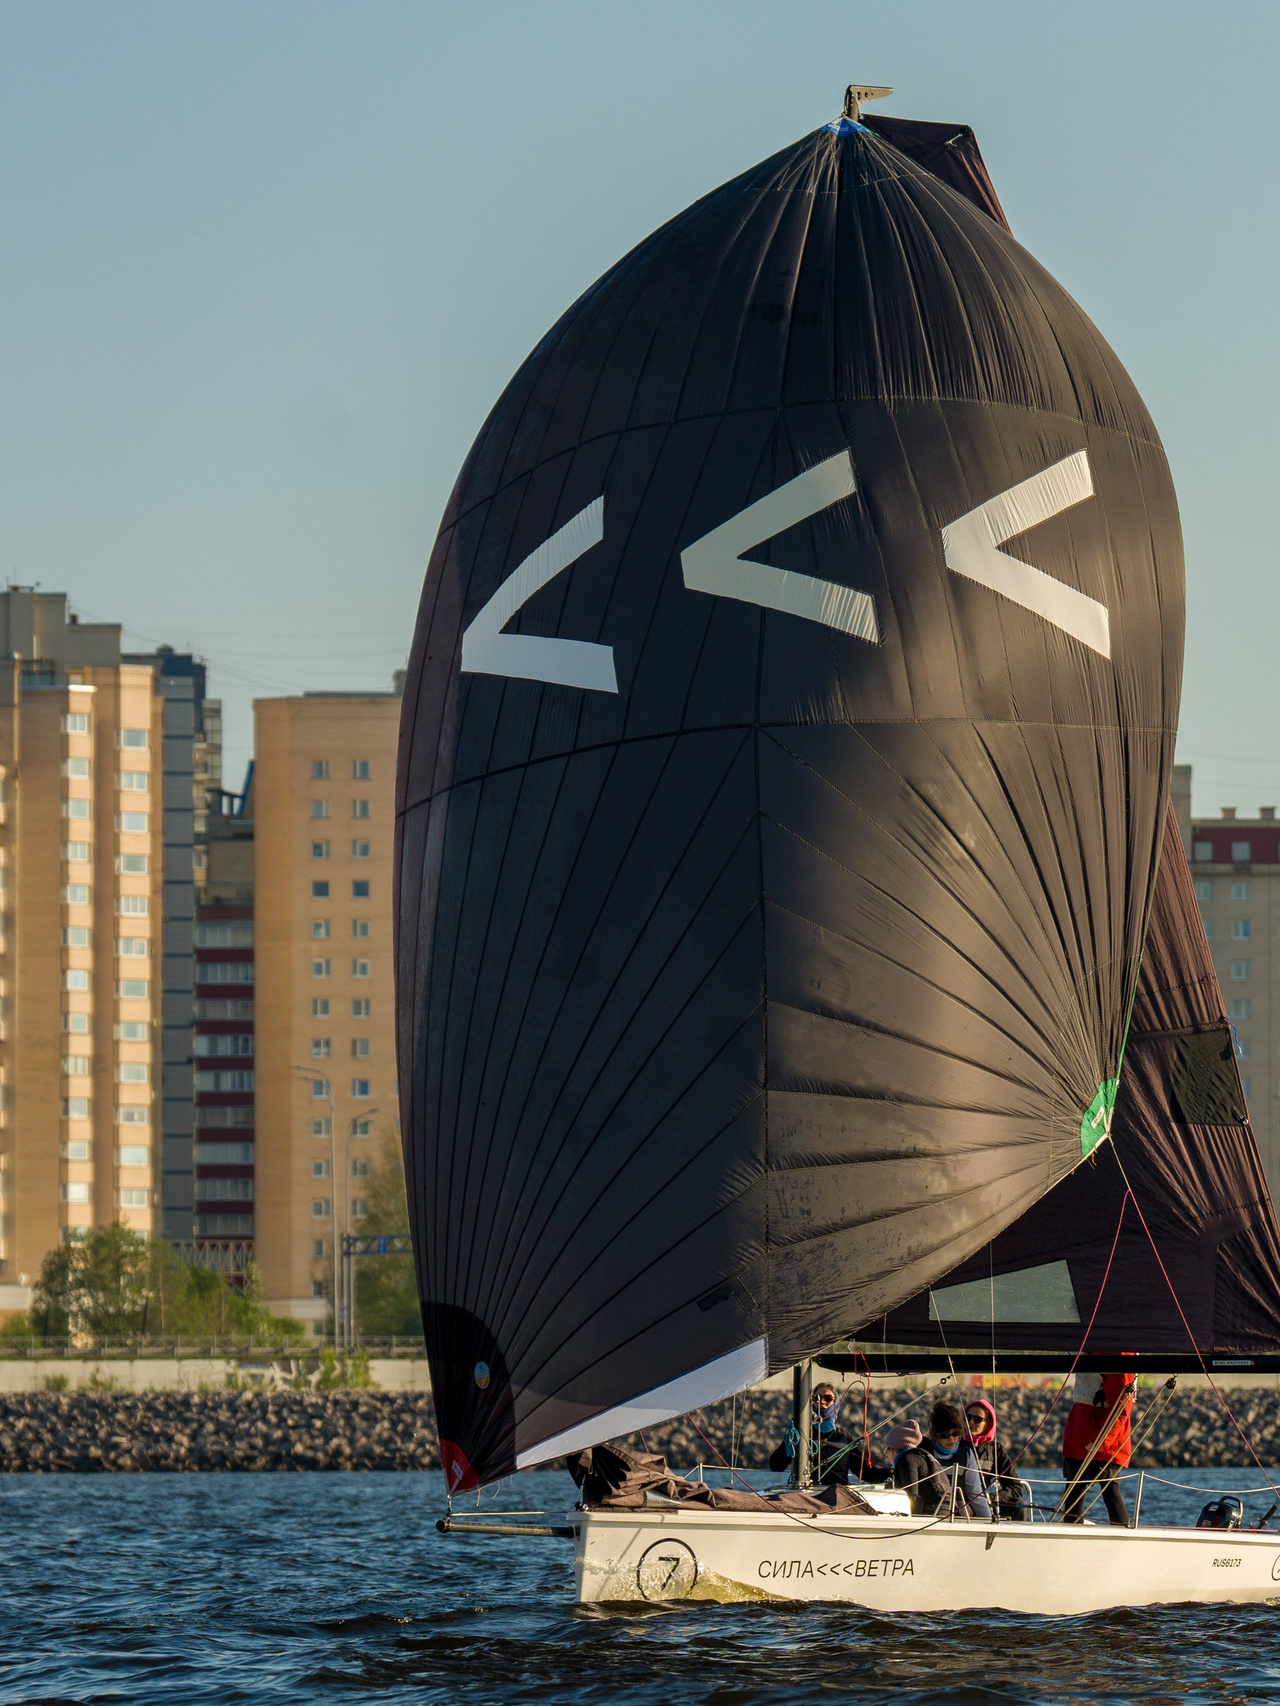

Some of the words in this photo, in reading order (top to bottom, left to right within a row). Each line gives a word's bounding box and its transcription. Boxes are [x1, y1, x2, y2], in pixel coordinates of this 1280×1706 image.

[758, 1558, 915, 1579] СИЛА<<<ВЕТРА
[1212, 1558, 1242, 1568] RUS6173
[658, 1556, 681, 1592] 7
